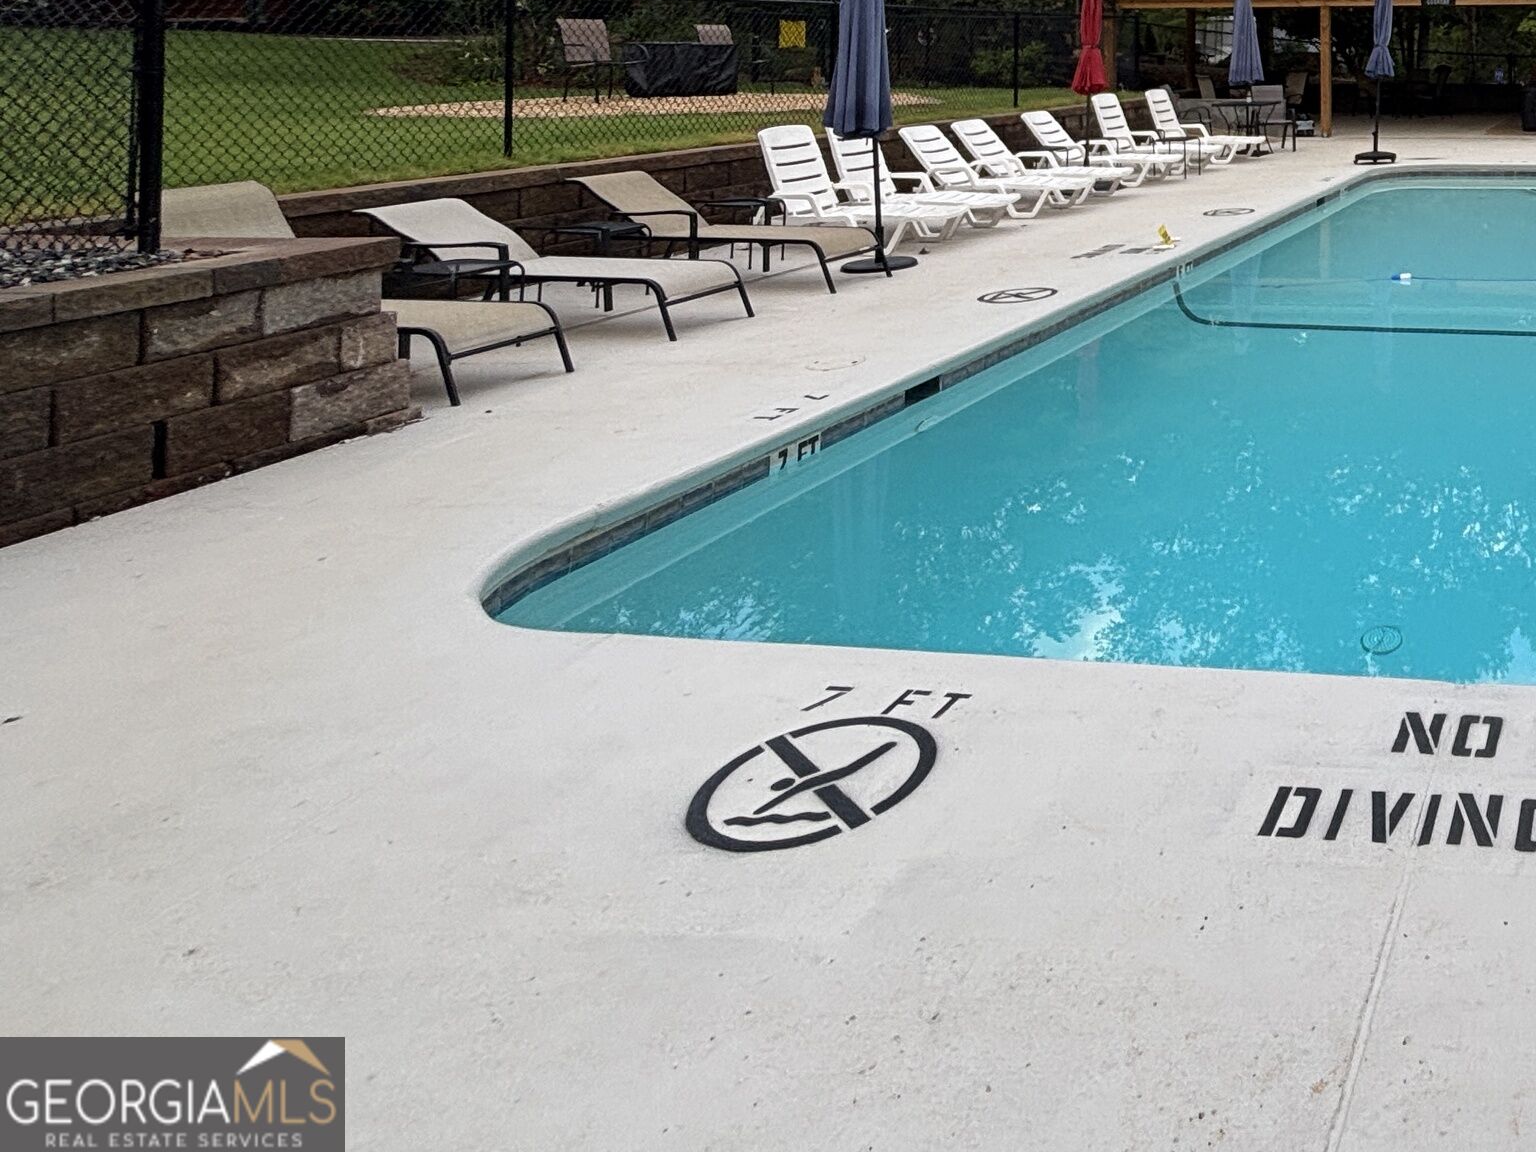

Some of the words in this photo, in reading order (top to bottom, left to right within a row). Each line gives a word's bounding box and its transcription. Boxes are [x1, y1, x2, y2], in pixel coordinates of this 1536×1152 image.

[778, 447, 789, 471] 7
[797, 434, 820, 462] FT
[800, 685, 855, 712] 7
[880, 689, 973, 719] FT
[1391, 711, 1504, 758] NO
